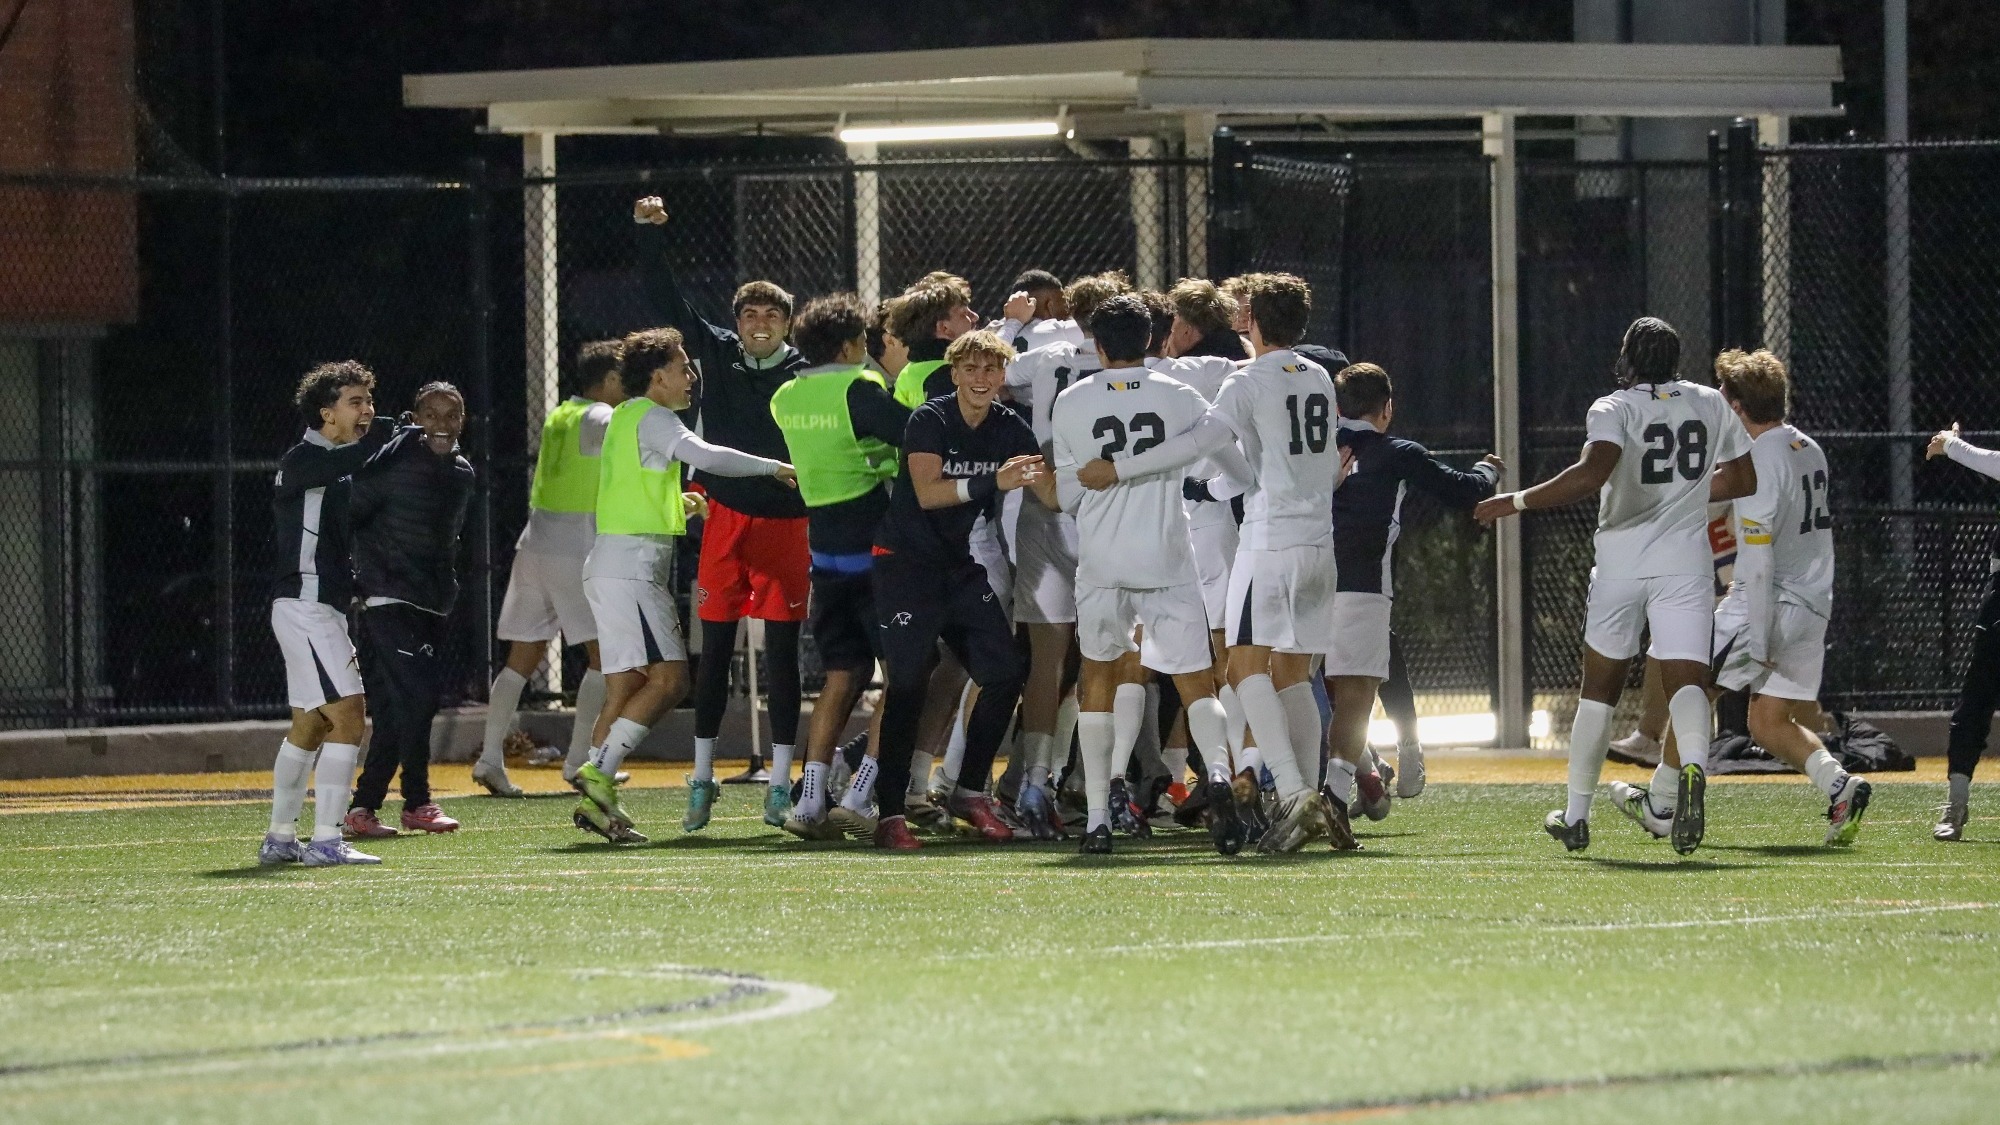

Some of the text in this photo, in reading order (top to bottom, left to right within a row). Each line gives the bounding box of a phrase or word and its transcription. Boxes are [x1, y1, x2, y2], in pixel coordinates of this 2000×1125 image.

[779, 414, 839, 430] DELPHI
[1092, 412, 1165, 462] 22
[1286, 394, 1329, 455] 18
[1641, 420, 1707, 484] 28
